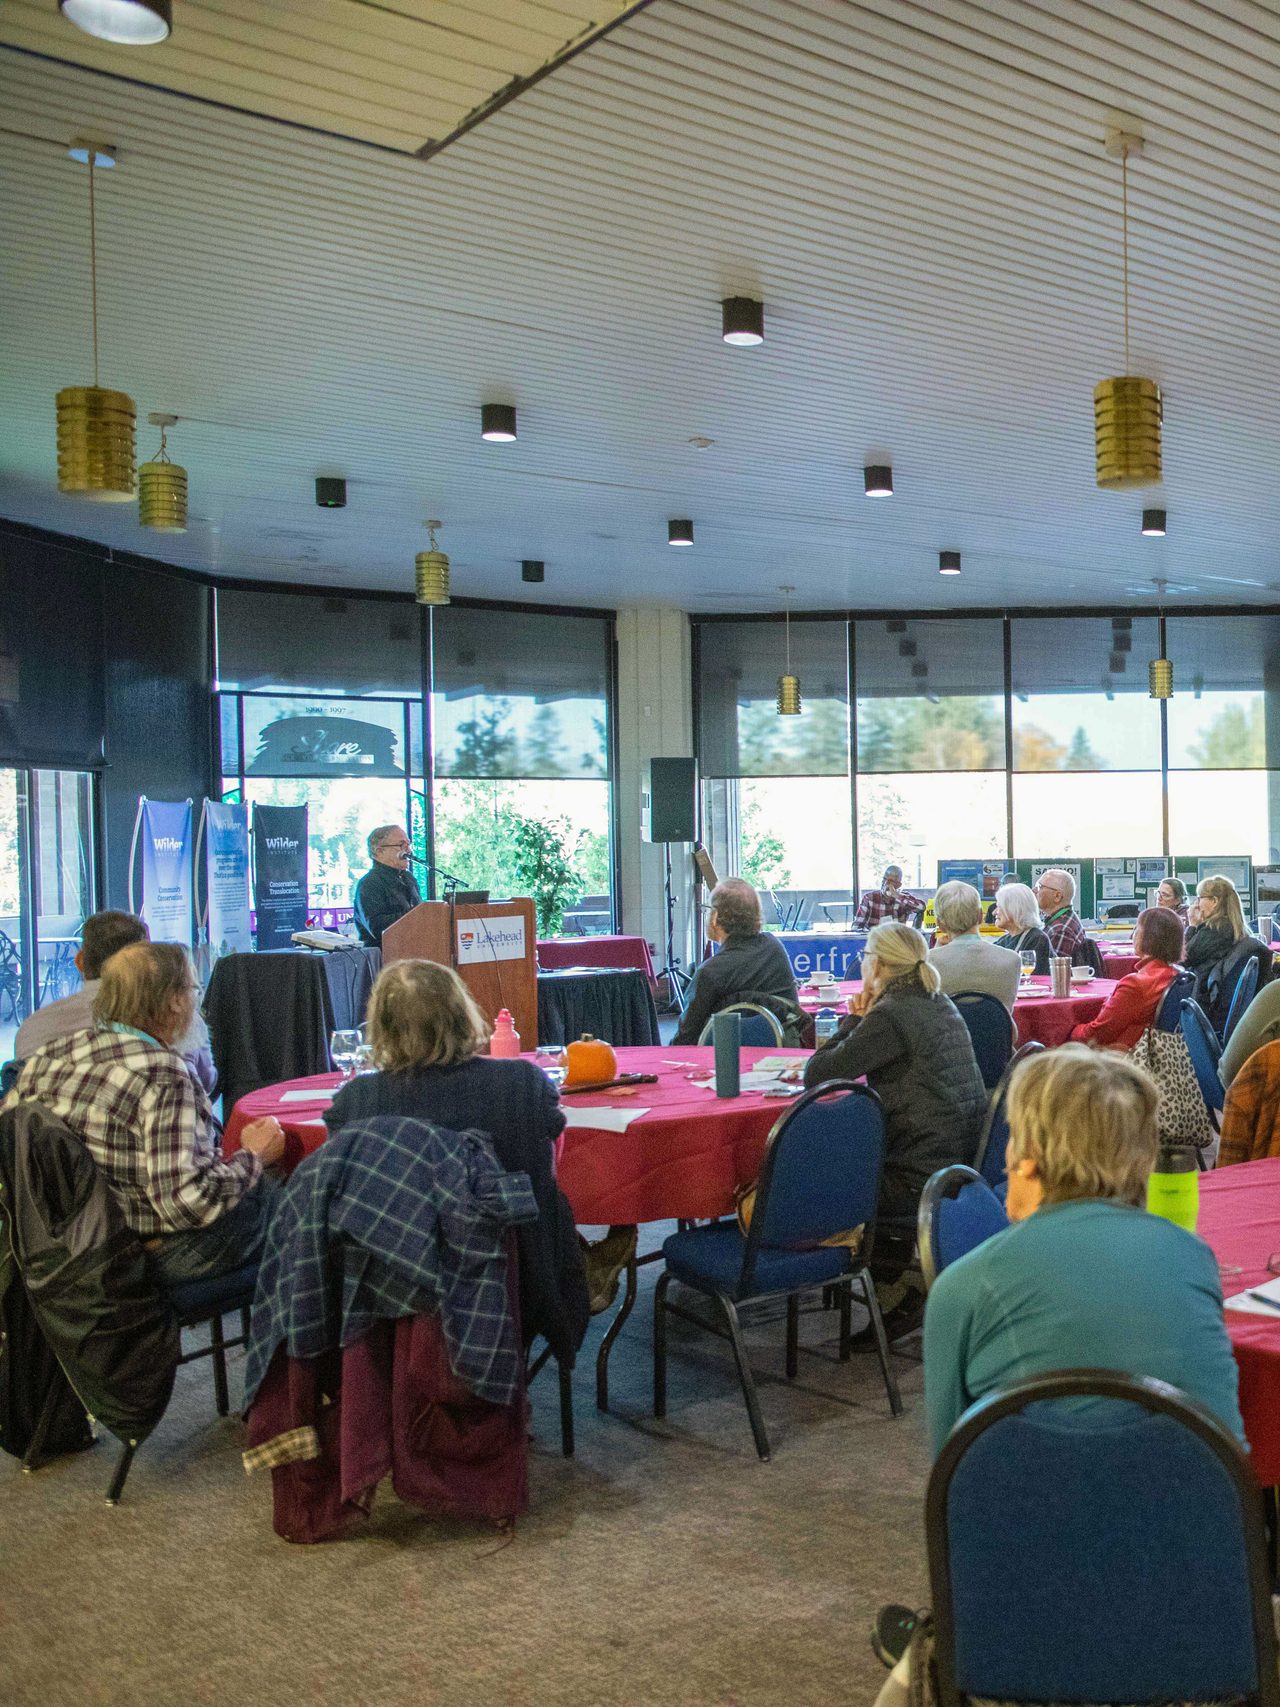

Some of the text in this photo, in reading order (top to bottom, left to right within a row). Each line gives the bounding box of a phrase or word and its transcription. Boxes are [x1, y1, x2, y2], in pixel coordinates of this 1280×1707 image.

[153, 837, 184, 852] Wilder
[265, 836, 299, 850] Wilder
[269, 880, 299, 888] Conservation
[269, 887, 300, 895] Translocation
[476, 928, 523, 944] Lakehead
